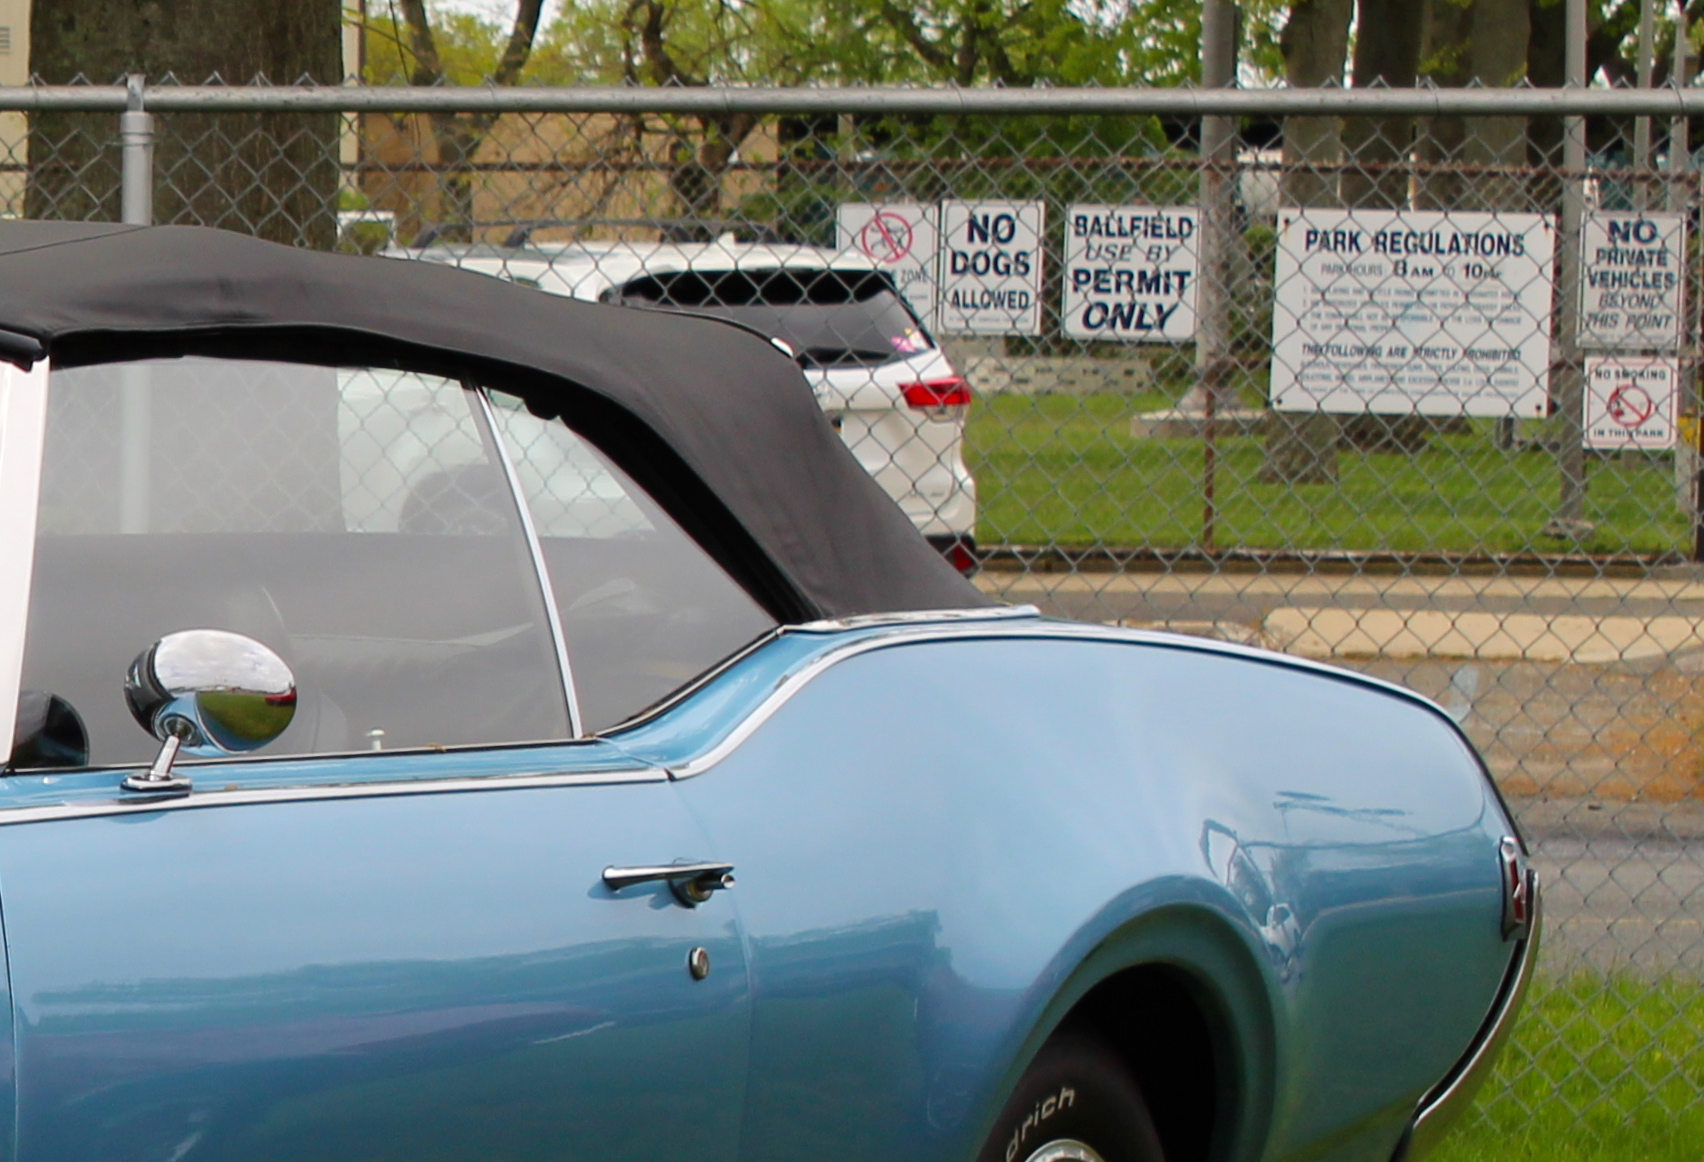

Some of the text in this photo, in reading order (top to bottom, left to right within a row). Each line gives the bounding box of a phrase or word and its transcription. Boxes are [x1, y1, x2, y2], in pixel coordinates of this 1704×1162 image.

[967, 213, 1016, 245] NO
[1074, 215, 1193, 238] BALLFIELD
[1608, 220, 1658, 244] NO
[1085, 244, 1132, 261] USE
[1305, 229, 1525, 257] PARK REGULATIONS
[951, 251, 1030, 277] DOGS
[1596, 248, 1668, 267] PRIVATE
[1072, 268, 1191, 295] PERMIT
[1411, 266, 1434, 277] AM
[1588, 271, 1675, 290] VEHICLES
[952, 290, 1030, 310] ALLOWED
[1082, 301, 1180, 331] ONLY
[1594, 369, 1667, 380] NO SMOKING
